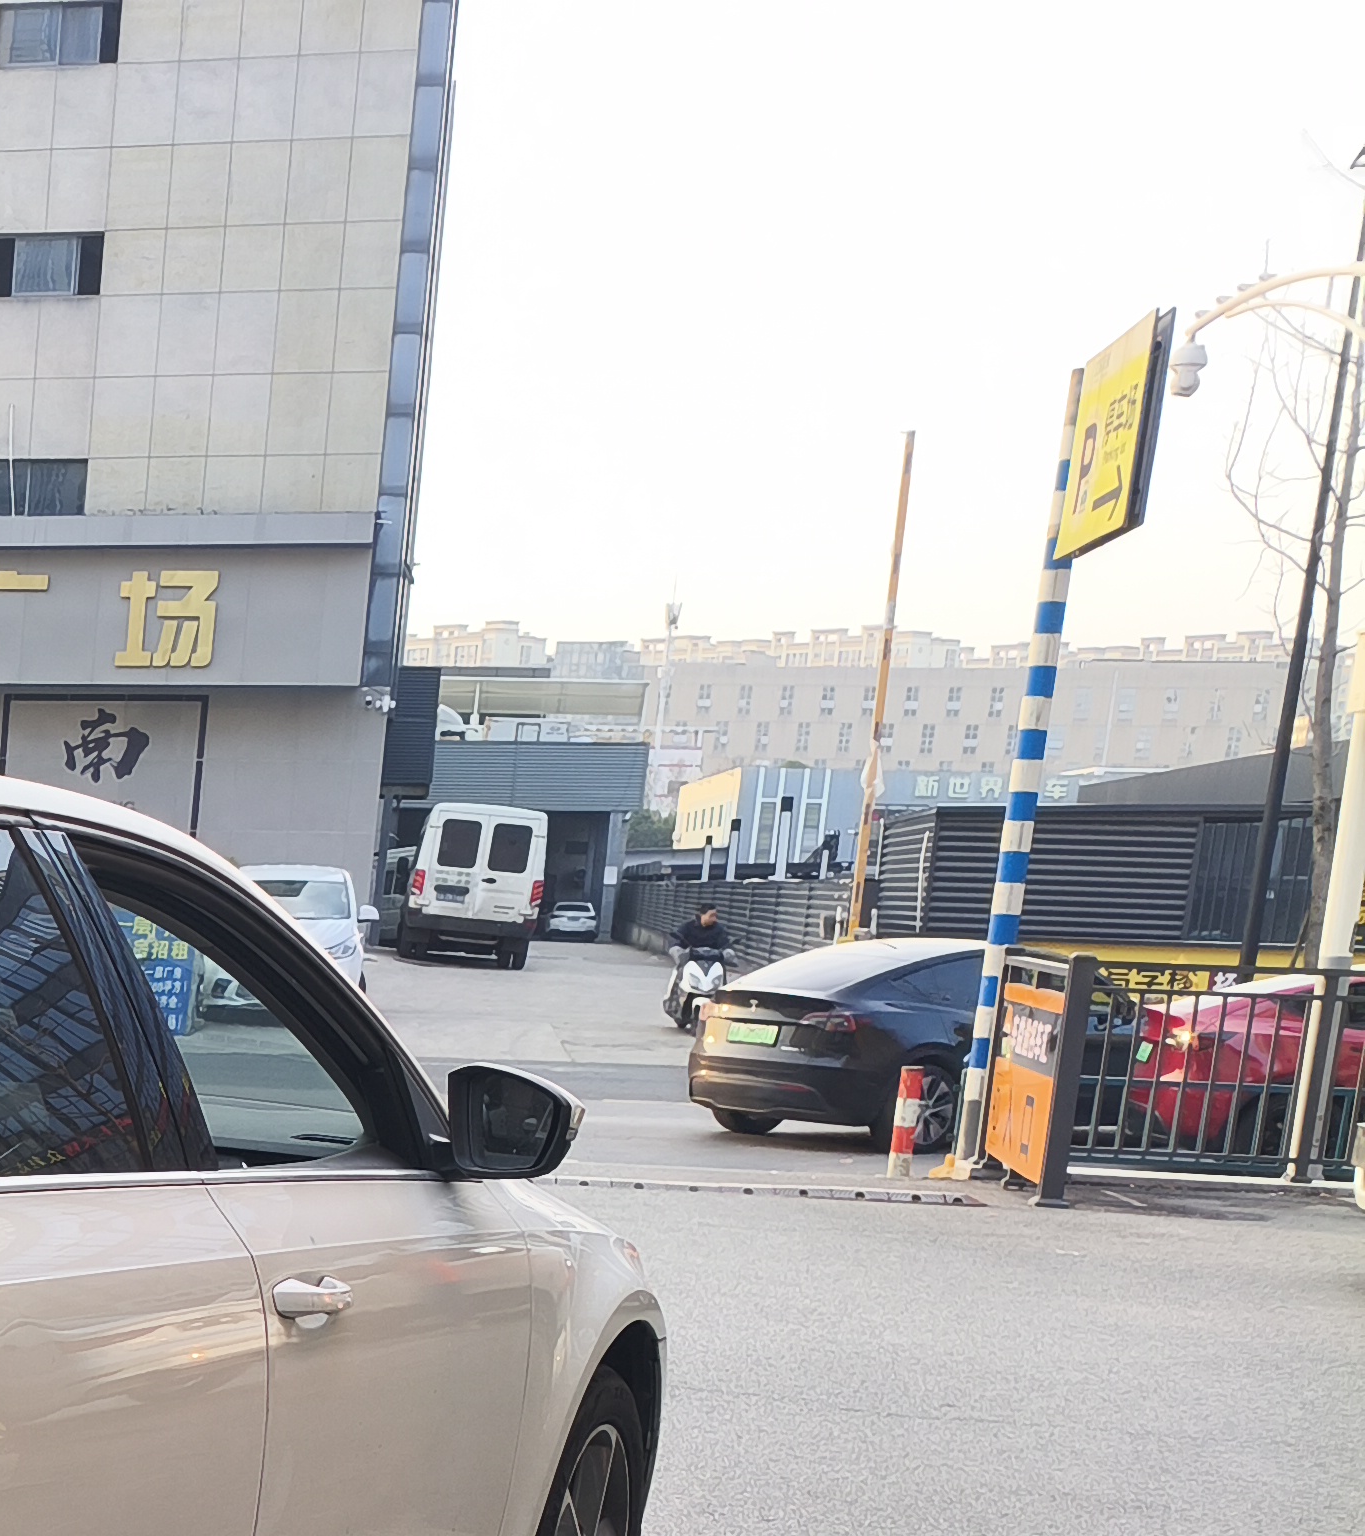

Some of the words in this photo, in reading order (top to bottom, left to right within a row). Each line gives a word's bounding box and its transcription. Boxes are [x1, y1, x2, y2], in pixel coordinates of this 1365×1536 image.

[1072, 422, 1098, 516] P
[63, 707, 150, 784] 南
[914, 775, 1069, 799] 新世界车
